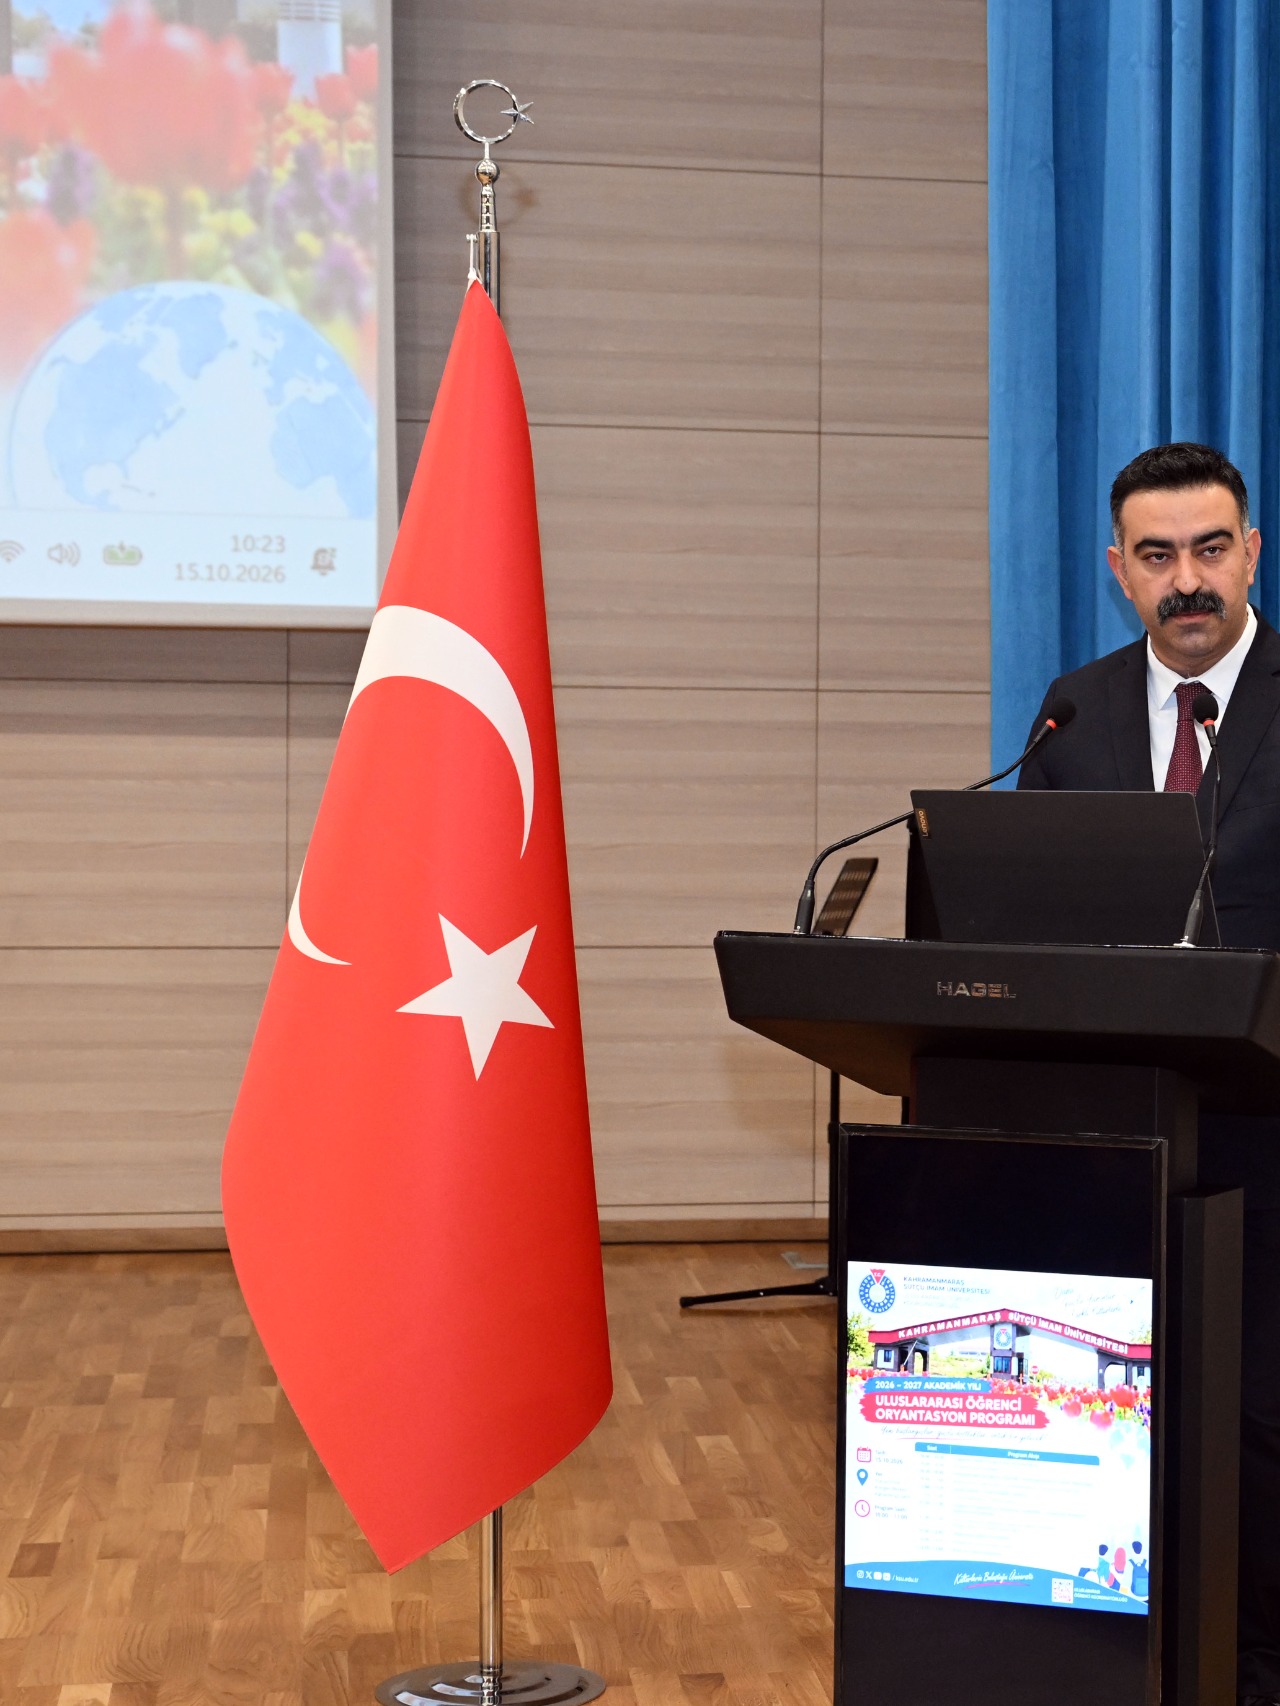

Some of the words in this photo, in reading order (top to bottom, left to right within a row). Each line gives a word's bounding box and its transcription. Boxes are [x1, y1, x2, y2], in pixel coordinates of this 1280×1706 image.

[231, 534, 286, 553] 10:23
[174, 563, 286, 583] 15.10.2026
[918, 810, 929, 837] Lenovo
[937, 981, 1017, 999] HAGEL
[898, 1312, 1001, 1339] KAHRAMANMARAŞ
[1008, 1311, 1037, 1327] SÜTÇÜ
[1038, 1317, 1062, 1334] İMAM
[1064, 1326, 1129, 1355] ÜNİVERSİTESİ
[875, 1380, 895, 1389] 2026
[903, 1381, 922, 1390] 2027
[923, 1381, 966, 1391] AKADEMİK
[966, 1382, 982, 1391] YILI
[875, 1394, 963, 1410] ULUSLARARASI
[965, 1395, 1022, 1411] ÖĞRENCİ
[875, 1408, 967, 1424] ORYANTASYON
[969, 1412, 1036, 1426] PROGRAMI
